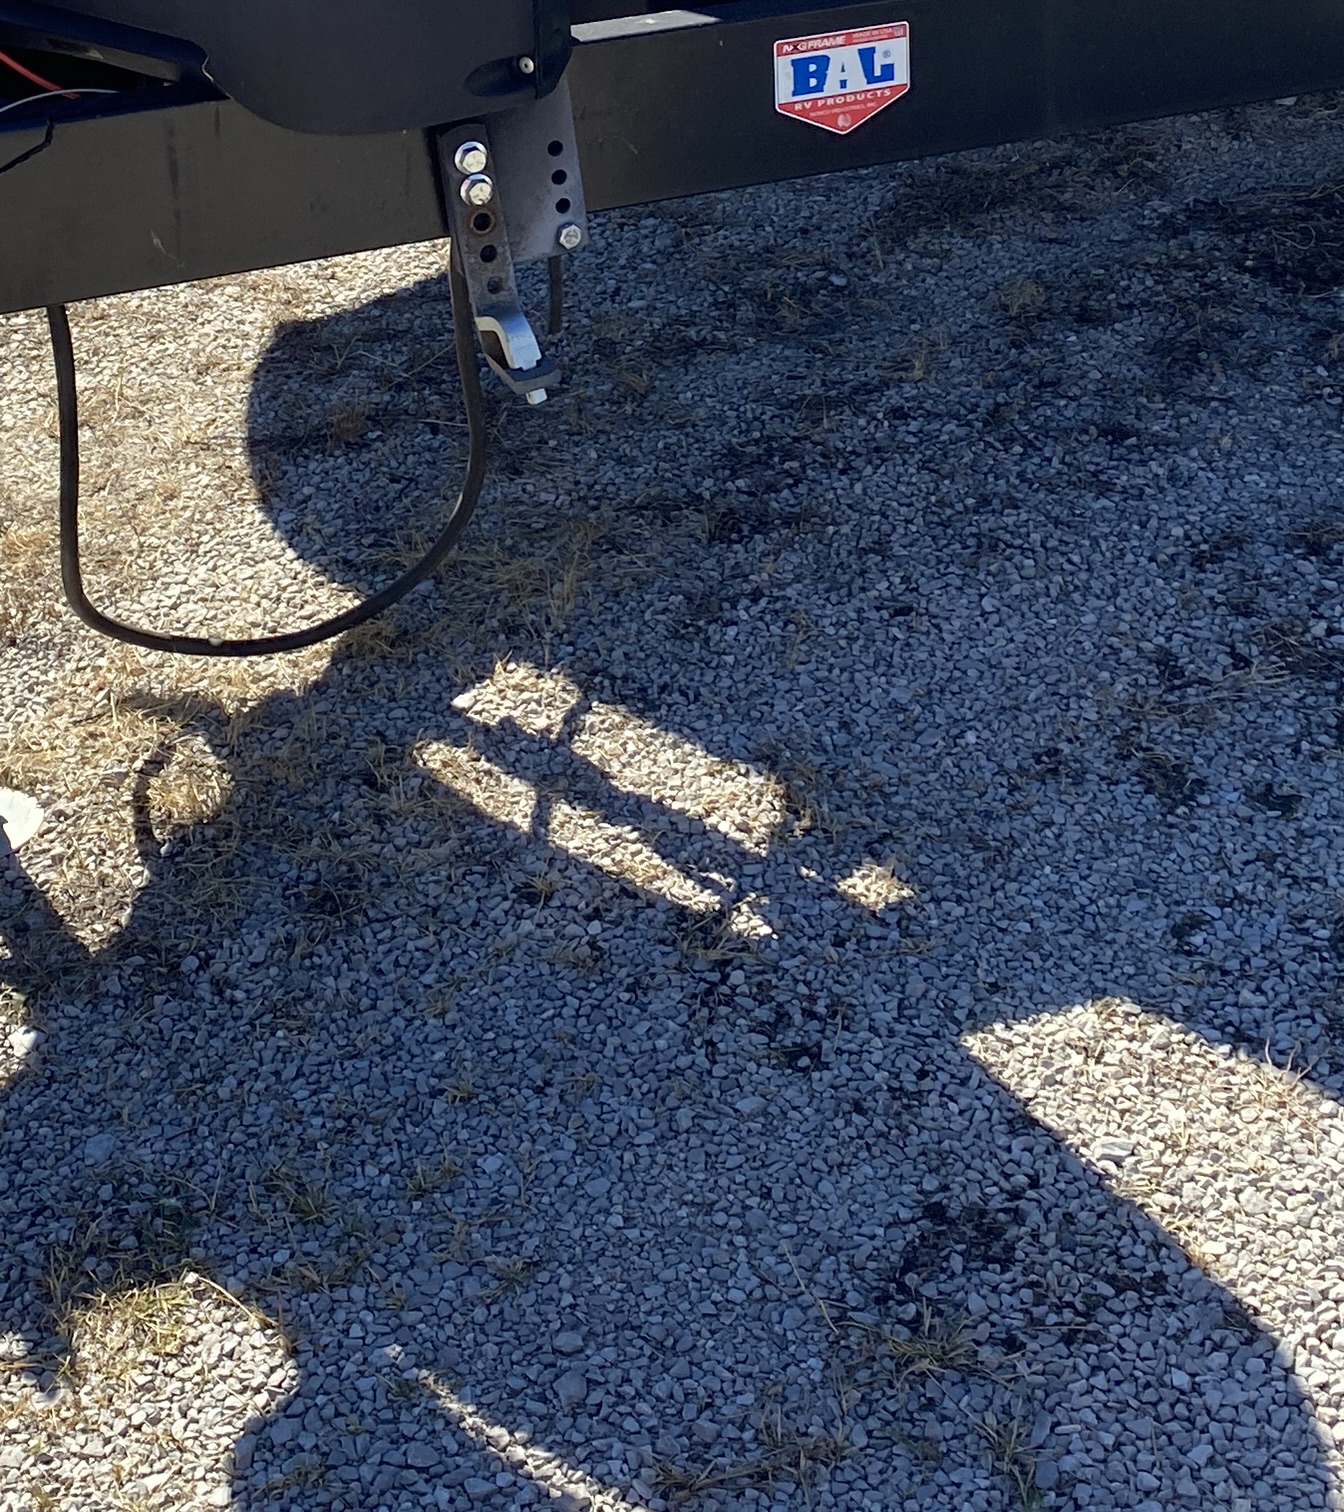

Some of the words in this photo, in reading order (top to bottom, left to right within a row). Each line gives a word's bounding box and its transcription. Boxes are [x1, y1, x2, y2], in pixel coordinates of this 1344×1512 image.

[807, 35, 846, 50] FRAME
[790, 46, 895, 97] BAL
[794, 101, 813, 111] RV
[817, 88, 892, 107] PRODUCTS
